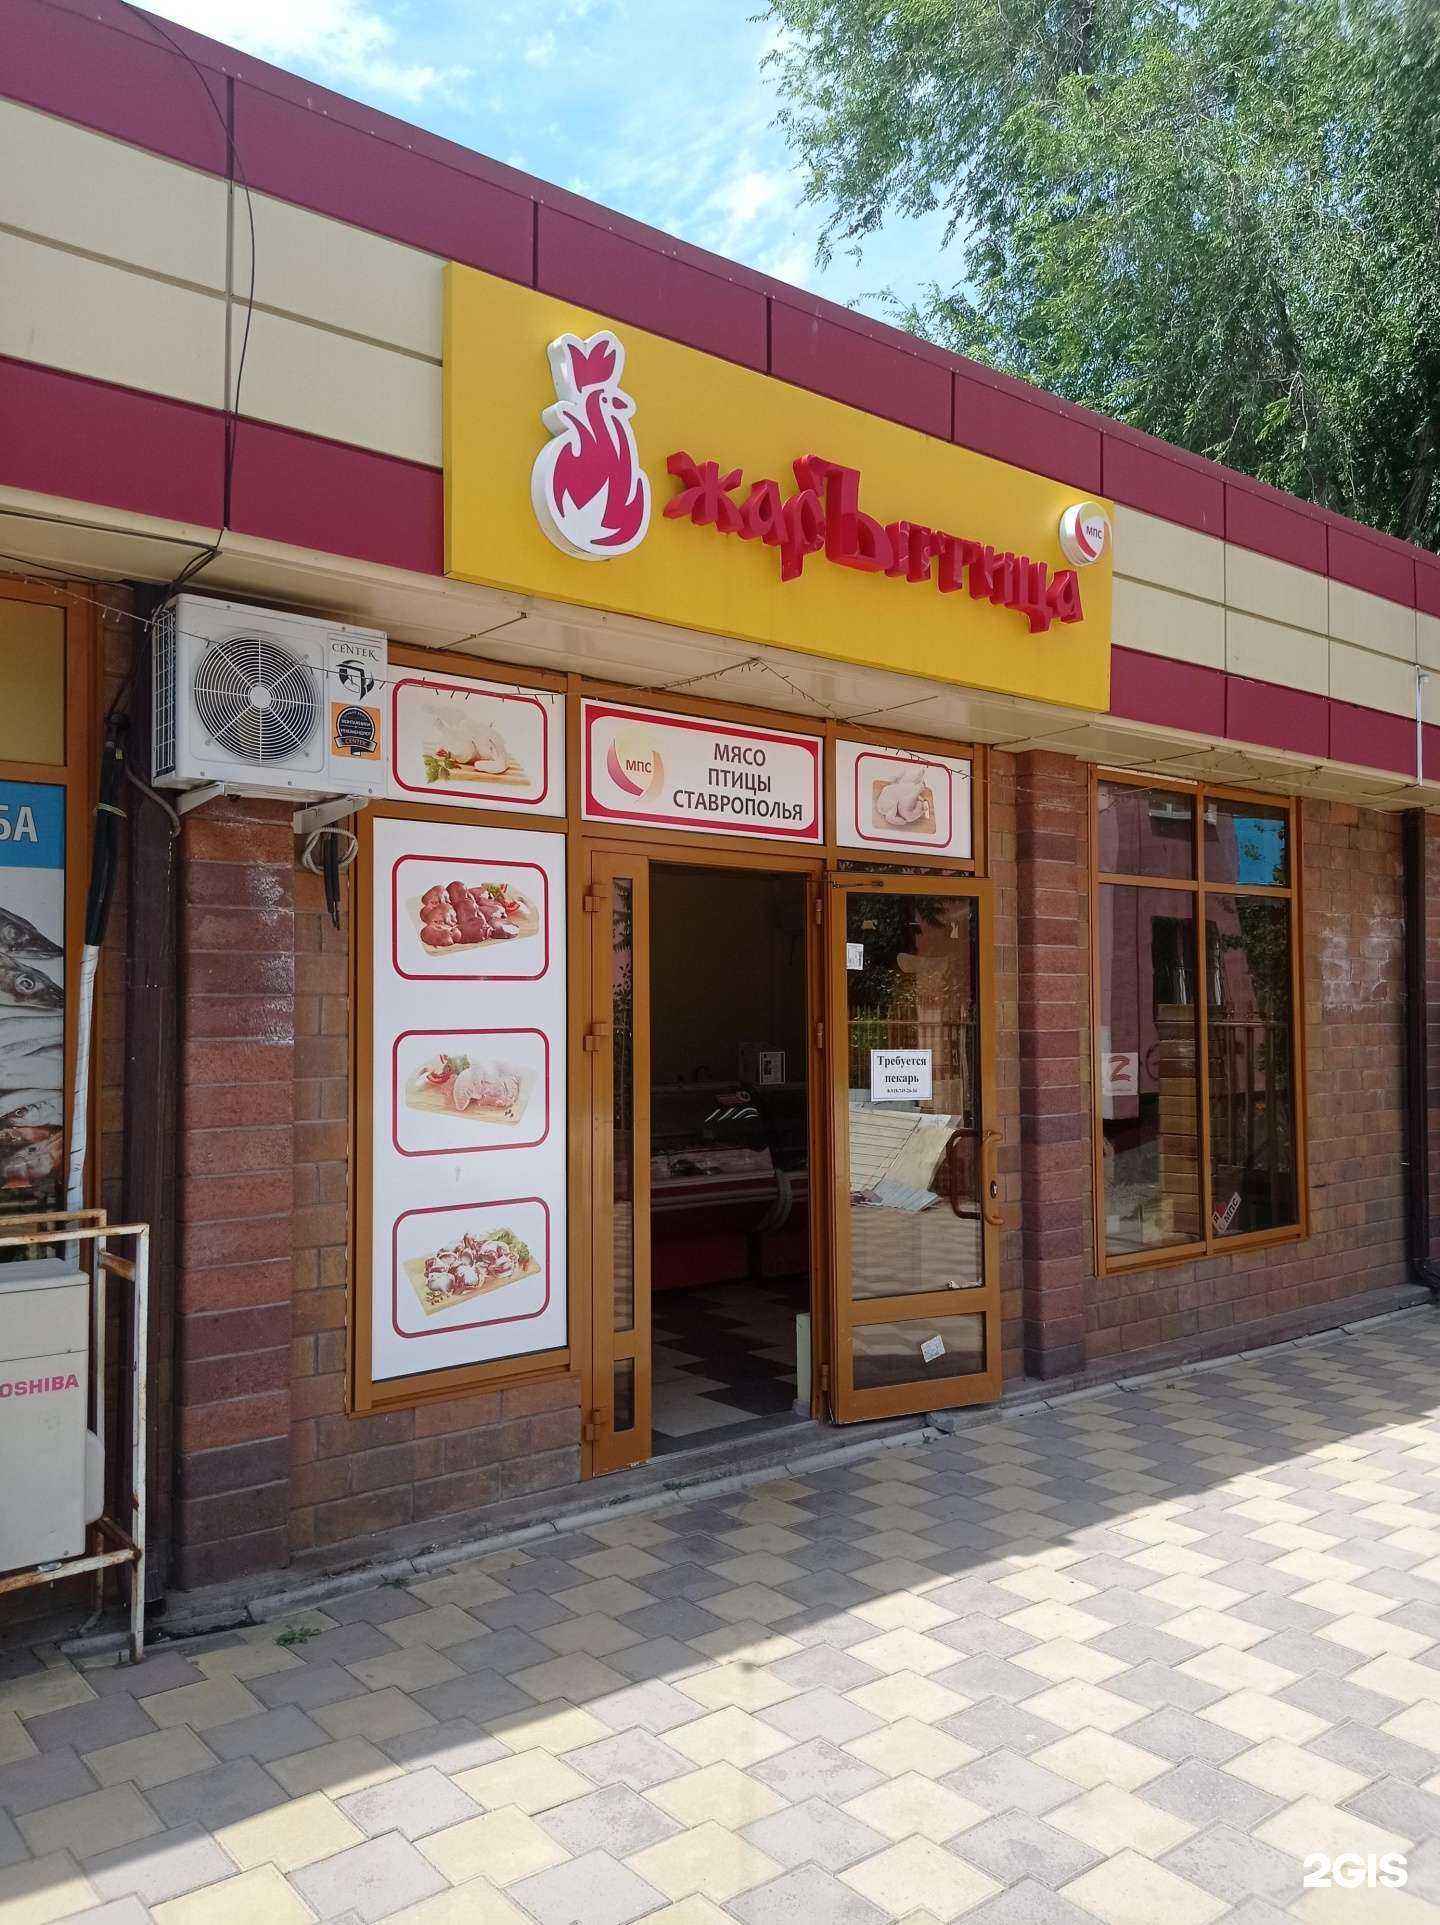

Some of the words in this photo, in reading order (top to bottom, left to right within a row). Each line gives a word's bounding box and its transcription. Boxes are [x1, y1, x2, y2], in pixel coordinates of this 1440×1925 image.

[1086, 525, 1103, 540] МПС
[331, 642, 379, 662] CENTEK
[713, 742, 766, 767] МЯСО
[625, 758, 653, 775] МПС
[708, 767, 771, 795] ПТИЦЫ
[672, 789, 803, 822] СТАВРОПОЛЬЯ
[877, 1056, 926, 1068] Требуется
[885, 1075, 919, 1085] пекарь
[0, 1374, 80, 1398] OSHIBA
